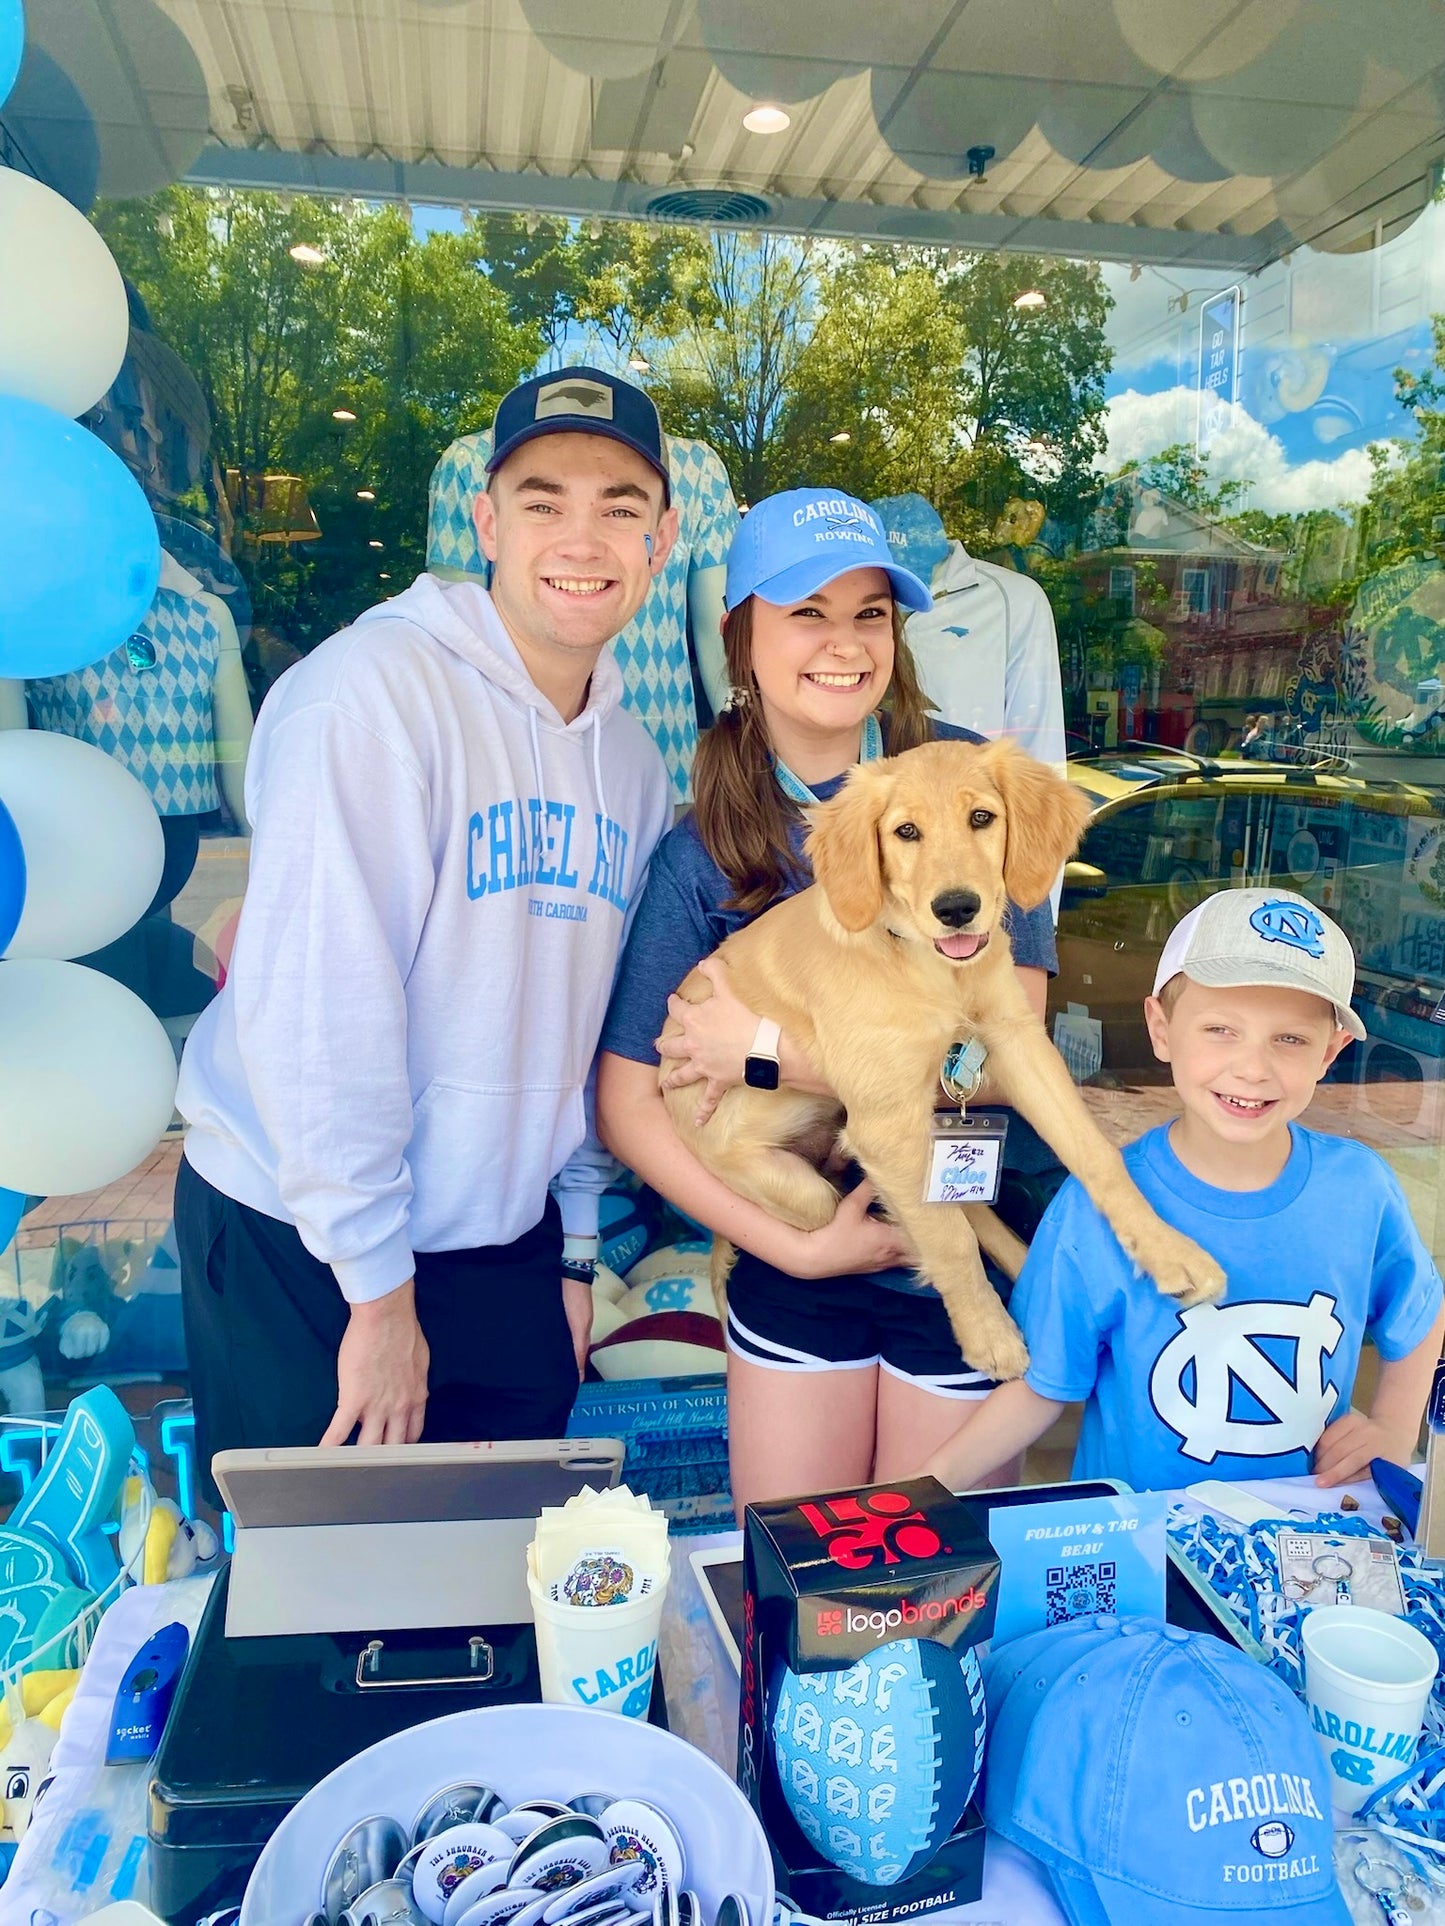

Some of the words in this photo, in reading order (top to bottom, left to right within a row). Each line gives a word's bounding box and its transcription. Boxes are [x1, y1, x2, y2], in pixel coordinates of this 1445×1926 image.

[1212, 330, 1224, 349] GO
[1210, 350, 1225, 370] TAR
[1204, 367, 1229, 390] HEELS
[793, 500, 880, 536] CAROLINA
[814, 531, 874, 546] ROWING
[545, 901, 588, 922] CAROLINA
[570, 1401, 657, 1418] UNIVERSITY
[662, 1399, 680, 1411] OF
[1025, 1522, 1092, 1541] FOLLOW
[1091, 1522, 1105, 1535] &
[1107, 1518, 1139, 1533] TAG
[1060, 1542, 1103, 1558] BEAU
[846, 1587, 988, 1639] logobrands
[742, 1589, 756, 1800] ogobrands
[1308, 1702, 1417, 1764] AROLINA
[1186, 1773, 1324, 1833] CAROLINA
[1223, 1855, 1320, 1883] FOOTBALL
[861, 1909, 889, 1924] SIZE
[892, 1890, 955, 1917] FOOTBALL
